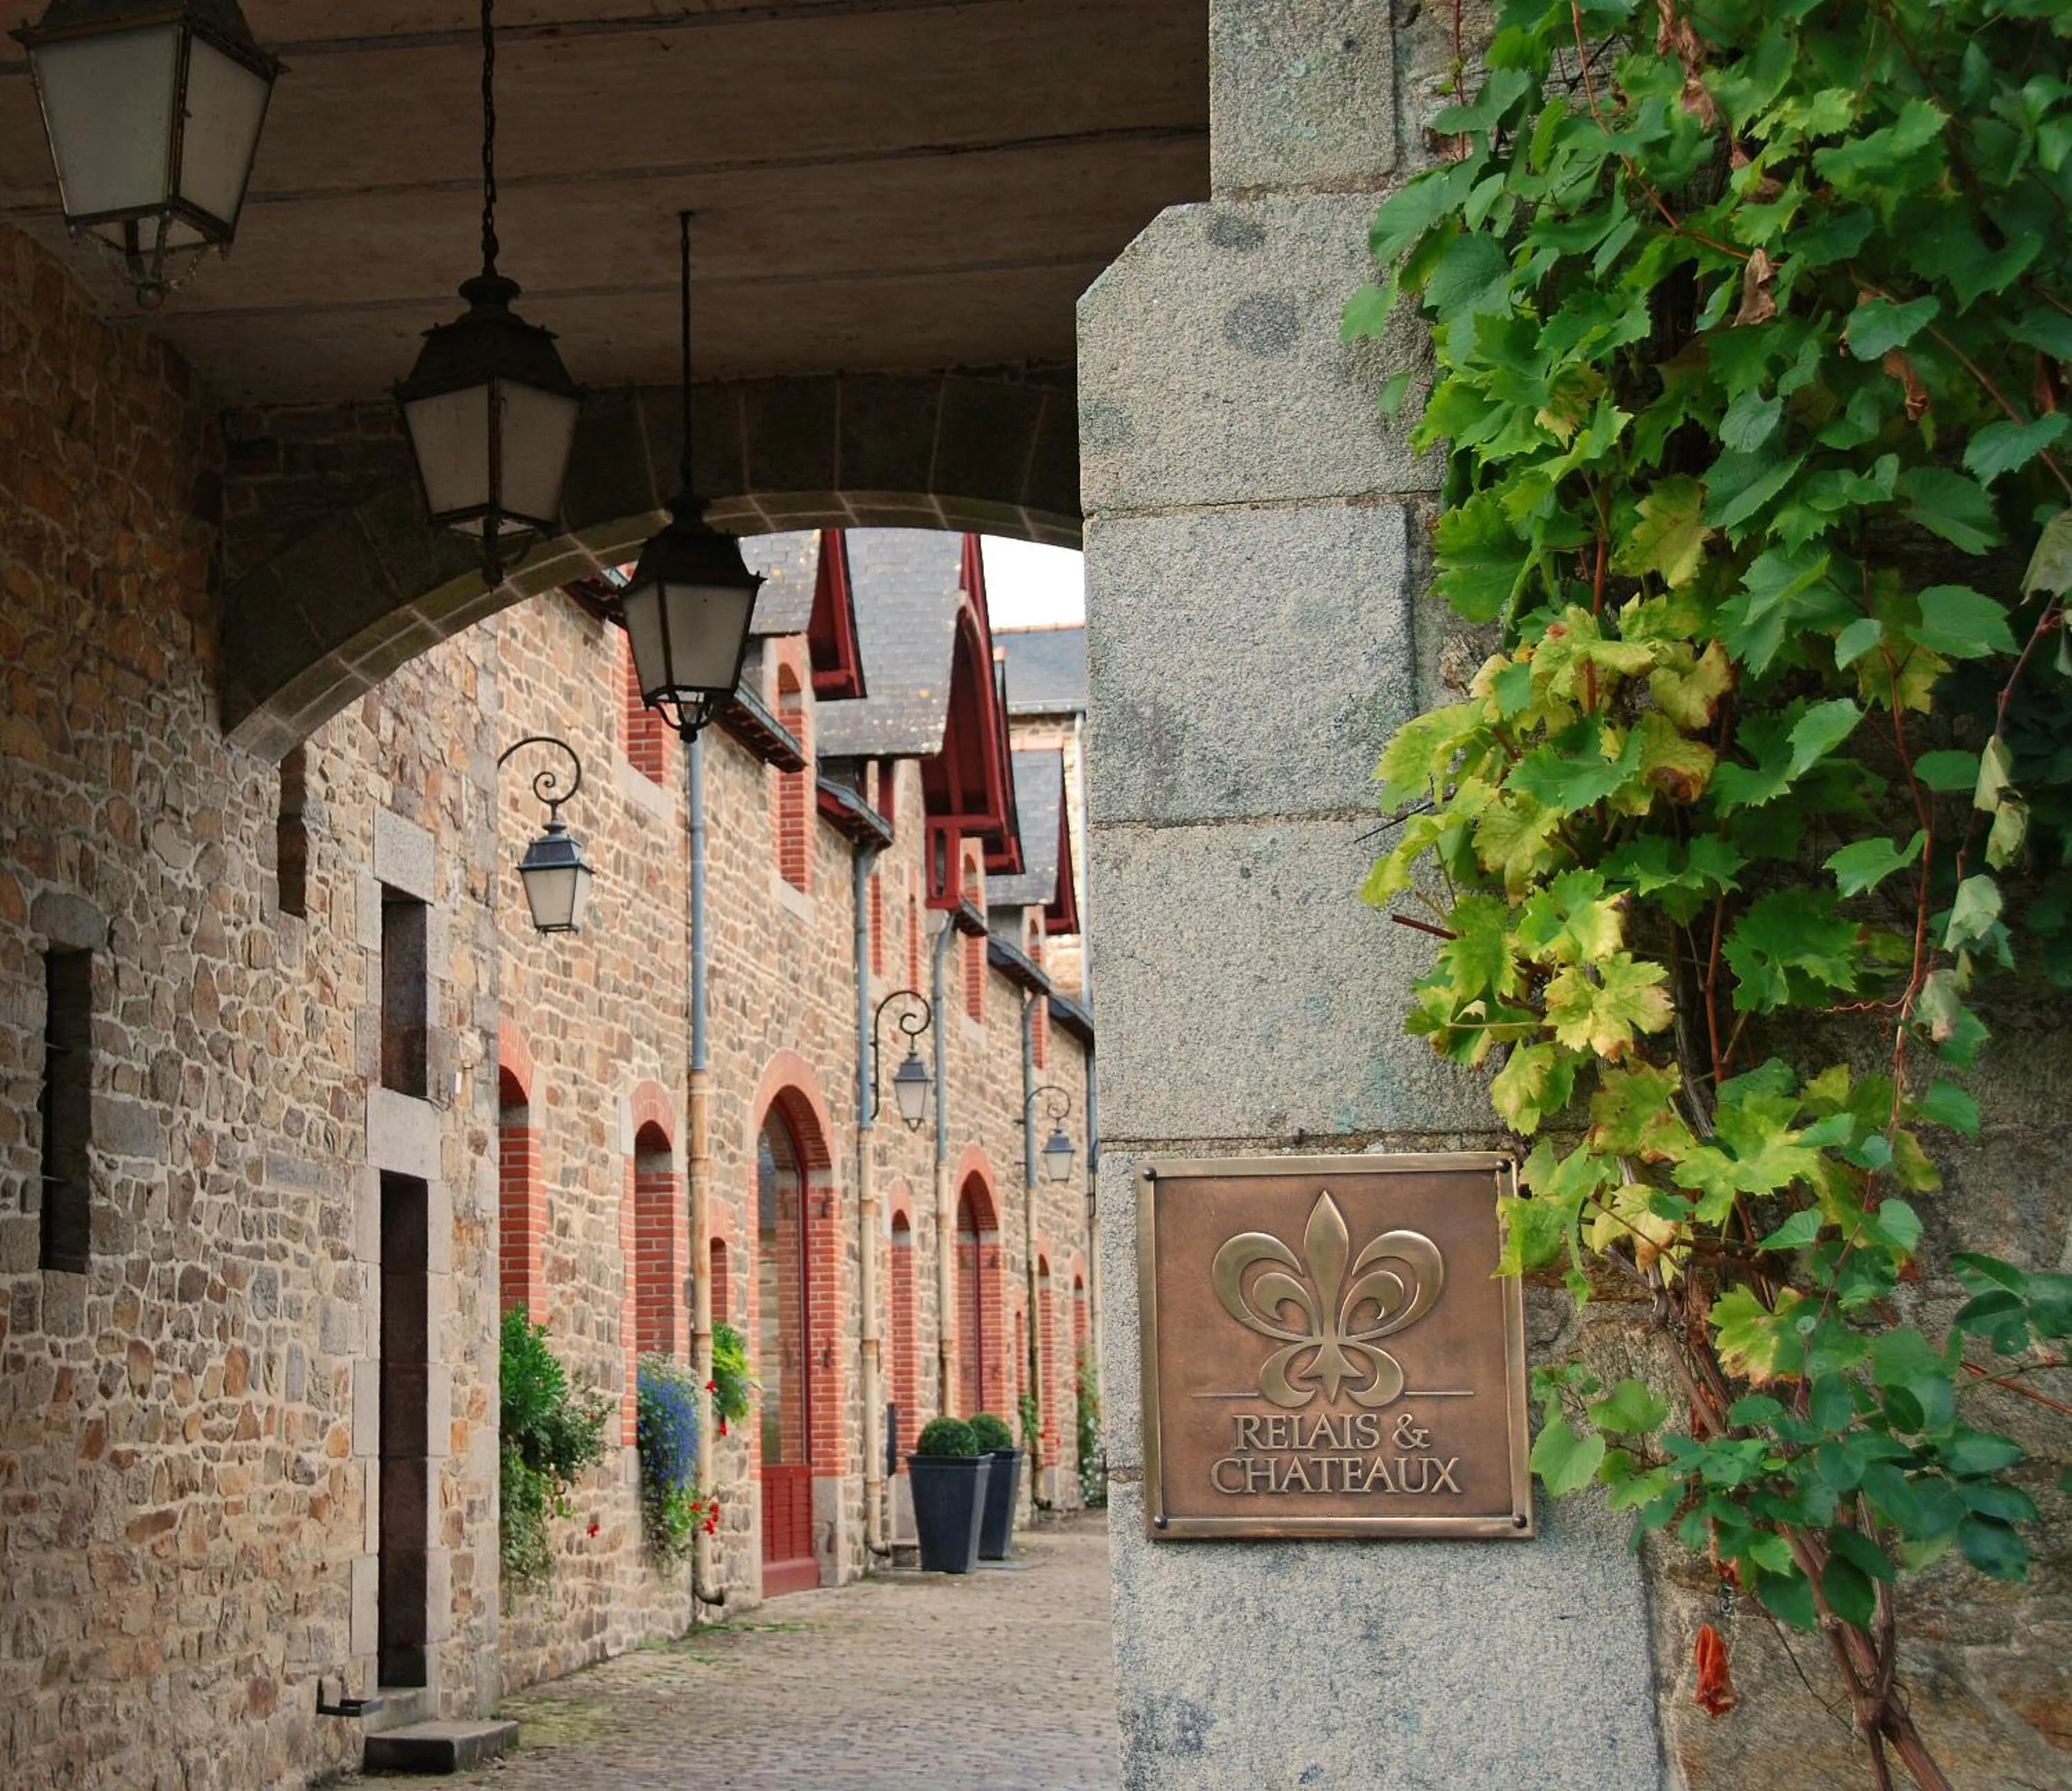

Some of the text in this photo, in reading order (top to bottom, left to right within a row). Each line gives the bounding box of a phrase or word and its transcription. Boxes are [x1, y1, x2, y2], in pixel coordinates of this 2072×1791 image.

[1233, 1414, 1430, 1450] RELAIS &
[1211, 1457, 1462, 1494] CHATEAUX
